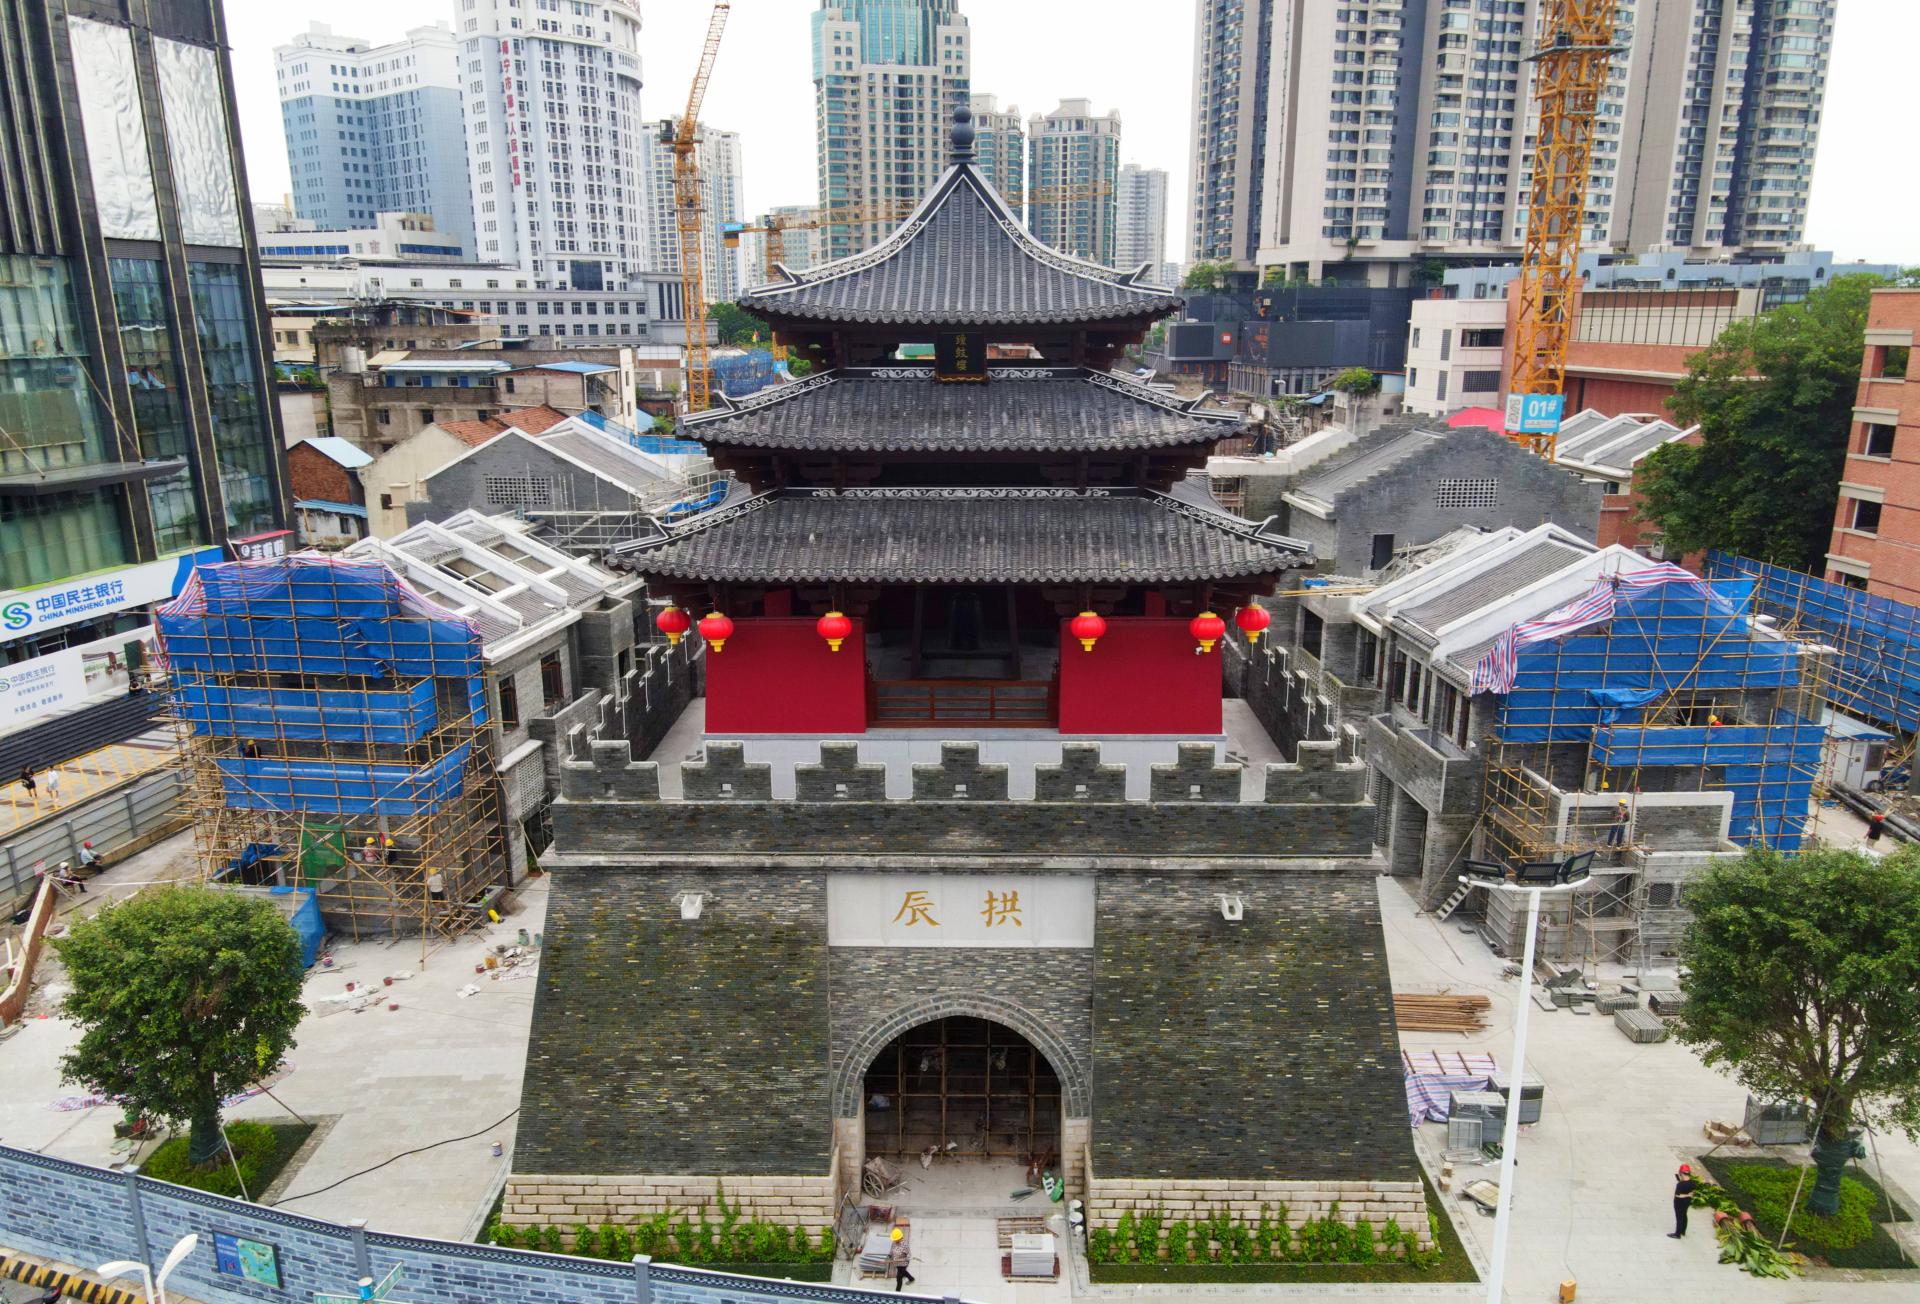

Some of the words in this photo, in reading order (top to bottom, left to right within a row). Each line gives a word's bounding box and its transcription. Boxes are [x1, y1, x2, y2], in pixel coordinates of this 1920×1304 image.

[501, 39, 521, 187] 南宁市第一人民医院
[1529, 399, 1557, 418] 01#
[36, 579, 123, 612] 中国民生银行
[39, 612, 64, 622] CHINA
[66, 600, 104, 616] MINSHENG
[106, 595, 125, 606] BANK
